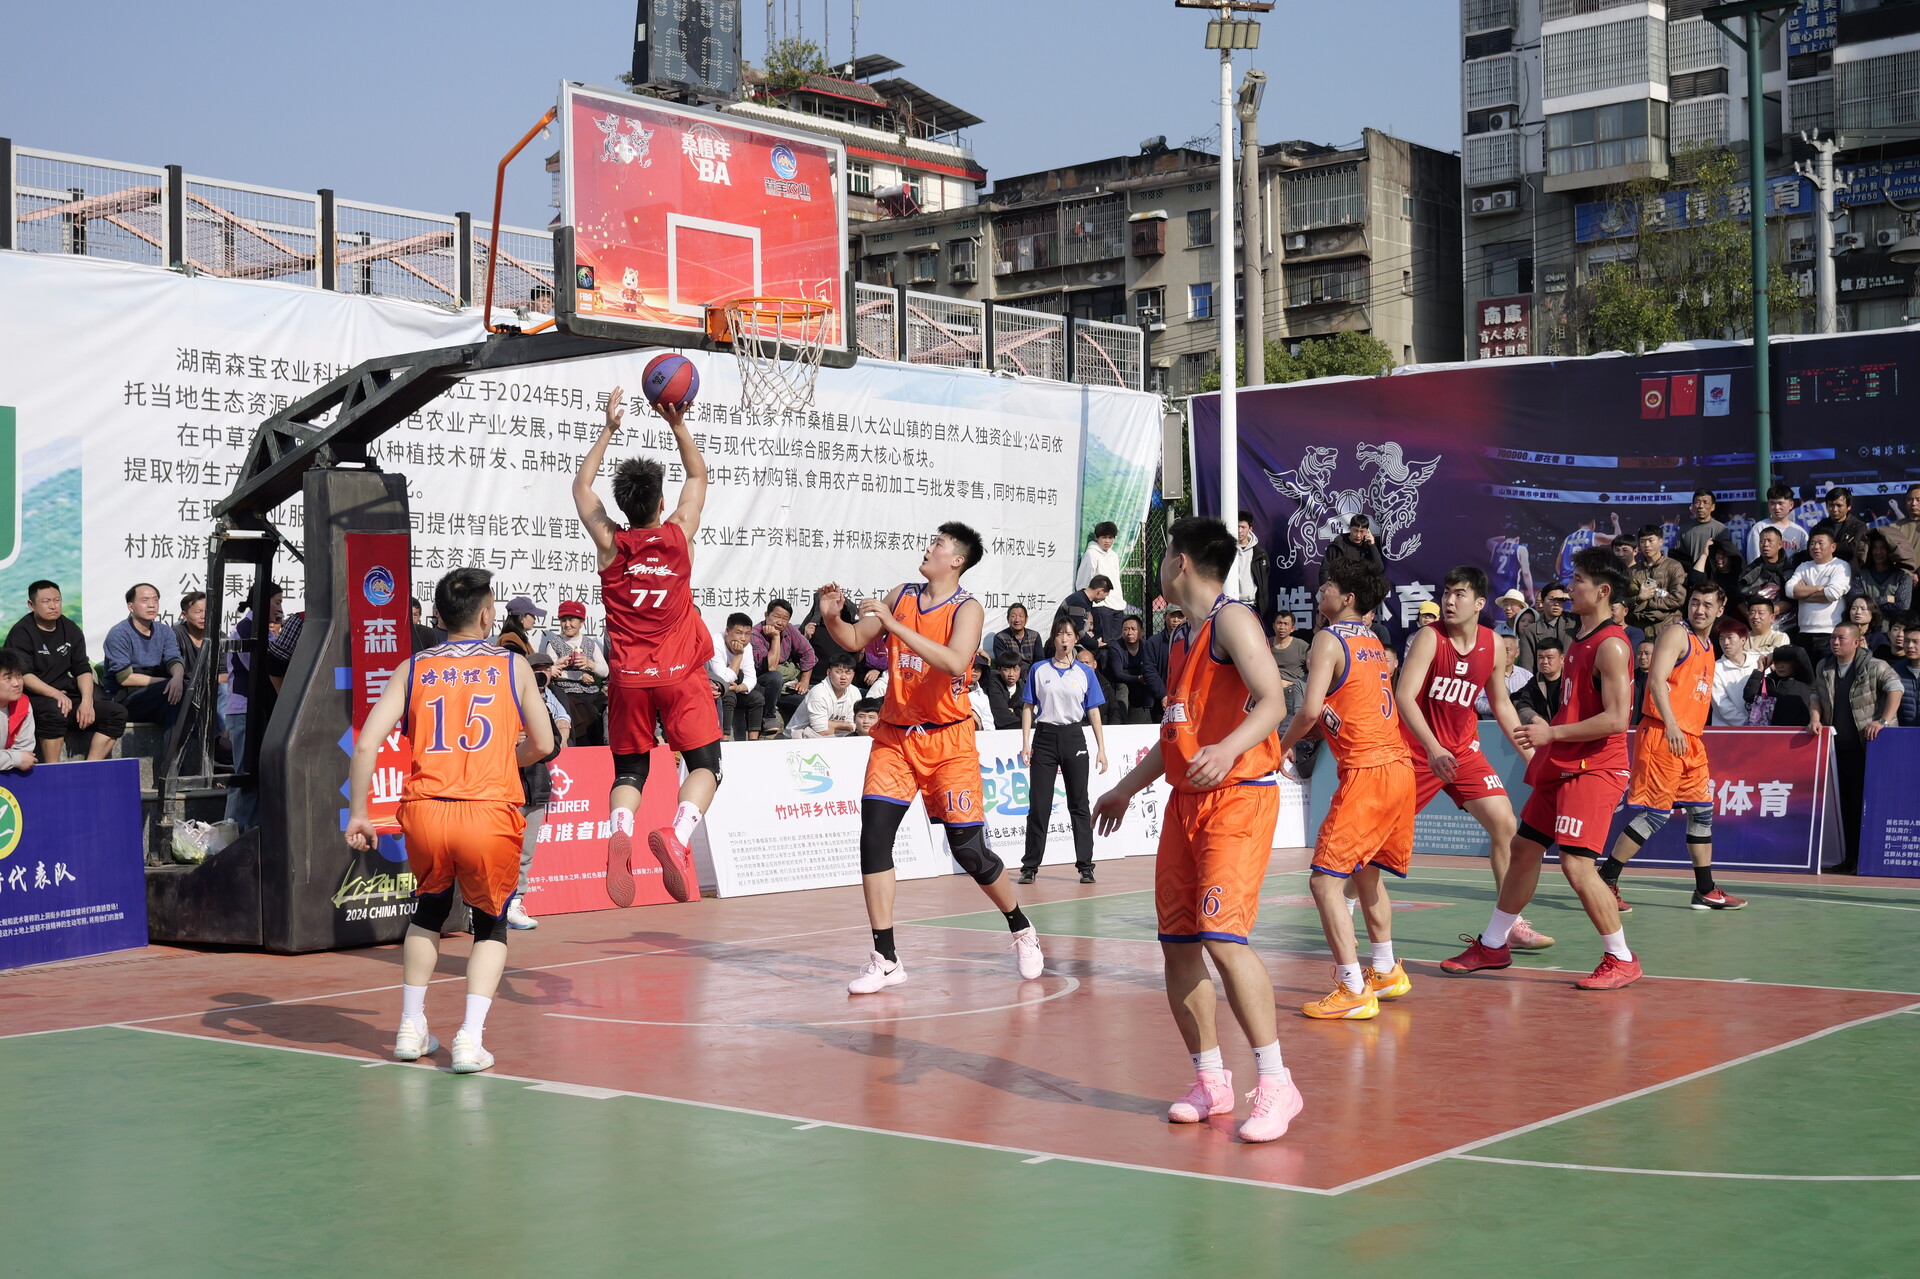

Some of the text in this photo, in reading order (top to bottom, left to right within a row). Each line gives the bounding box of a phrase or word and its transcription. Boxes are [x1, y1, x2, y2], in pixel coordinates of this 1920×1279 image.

[681, 133, 732, 161] 桑植年
[696, 157, 732, 186] BA
[1484, 304, 1521, 325] 南康
[630, 589, 668, 608] 77
[1455, 661, 1469, 675] 9
[1380, 671, 1394, 719] 5
[1428, 676, 1478, 707] HOU
[425, 693, 496, 753] 15
[774, 799, 861, 821] 竹叶坪乡代表队
[944, 789, 972, 812] 16
[1708, 780, 1793, 817] 体育
[537, 815, 635, 844] 镇准者体
[345, 907, 368, 921] 2024
[369, 904, 397, 919] CHINA
[1202, 886, 1223, 917] 6
